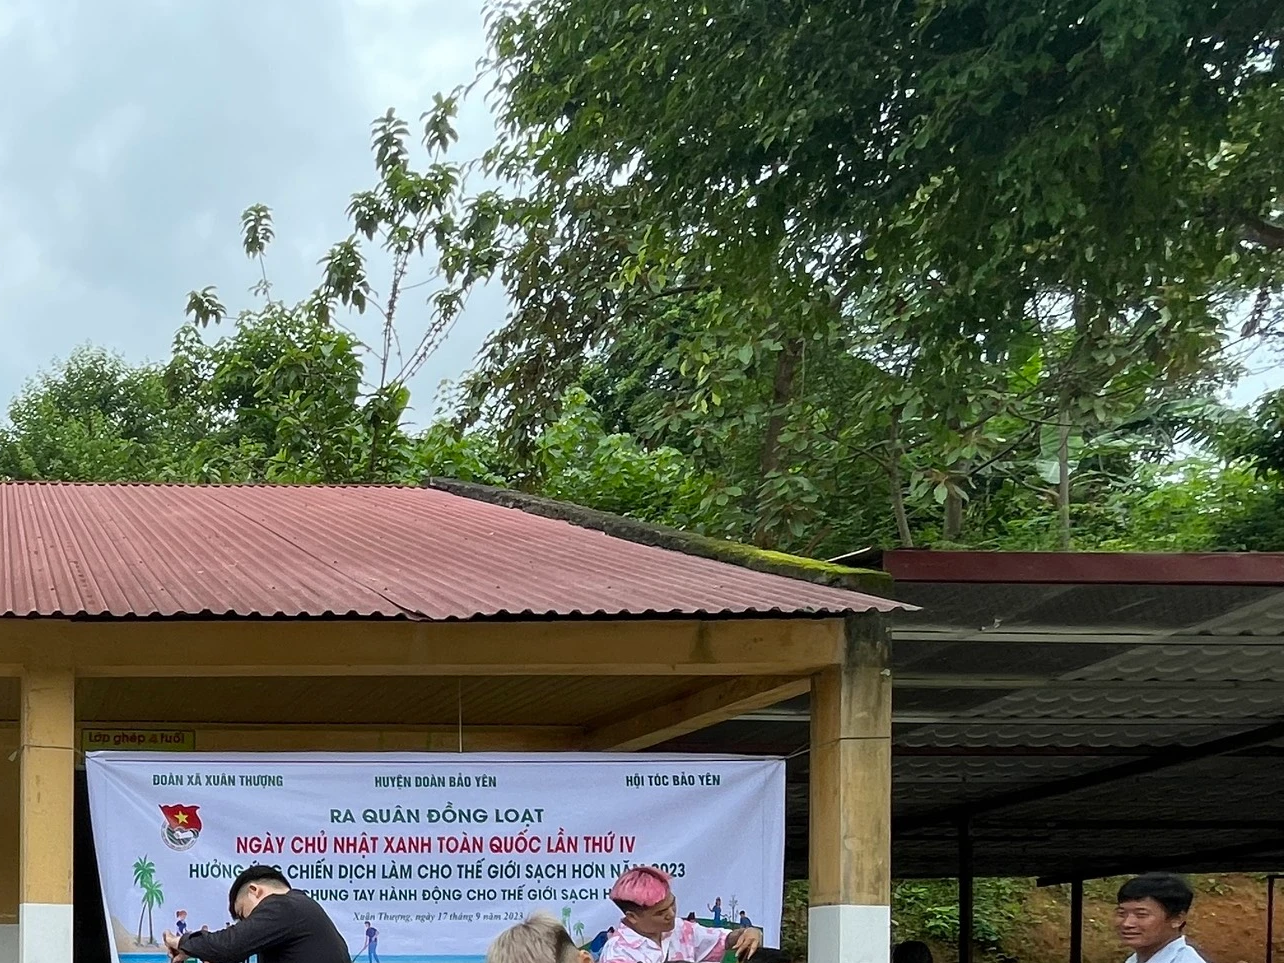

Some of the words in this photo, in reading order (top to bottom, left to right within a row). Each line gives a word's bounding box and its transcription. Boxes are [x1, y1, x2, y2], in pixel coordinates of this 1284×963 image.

[152, 772, 184, 786] ĐOÀN
[187, 772, 202, 787] XÃ
[205, 772, 236, 787] XUÂN
[239, 774, 283, 789] THƯỢNG
[375, 774, 411, 790] HUYỆN
[415, 773, 446, 788] ĐOÀN
[449, 772, 471, 788] BẢO
[475, 773, 497, 788] YÊN
[626, 773, 645, 789] HỘI
[648, 773, 669, 787] TÓC
[672, 771, 695, 786] BẢO
[698, 772, 721, 786] YÊN
[330, 808, 356, 823] RA
[362, 805, 420, 823] QUÂN
[426, 801, 488, 823] ĐỒNG
[495, 808, 544, 827] LOẠT
[236, 831, 285, 855] NGÀY
[290, 829, 328, 854] CHỦ
[333, 832, 378, 859] NHẬT
[383, 836, 432, 853] XANH
[437, 831, 483, 853] TOÀN
[488, 828, 541, 853] QUỐC
[547, 827, 578, 853] LẦN
[583, 831, 616, 853] THỨ
[620, 836, 636, 853] IV
[189, 859, 244, 879] HƯỞNG
[287, 858, 333, 879] CHIẾN
[338, 864, 376, 884] DỊCH
[381, 860, 413, 879] LÀM
[418, 864, 452, 879] CHO
[457, 858, 485, 879] THẾ
[487, 860, 521, 879] GIỚI
[525, 864, 567, 883] SẠCH
[571, 862, 605, 879] HƠN
[354, 889, 376, 901] TAY
[379, 886, 417, 901] HÀNH
[422, 886, 462, 904] ĐỘNG
[467, 889, 497, 901] CHO
[501, 884, 526, 901] THẾ
[528, 885, 557, 901] GIỚI
[561, 888, 598, 904] SẠCH
[353, 912, 376, 921] Xuân
[415, 913, 436, 922] ngày
[438, 912, 449, 921] 17
[449, 912, 474, 922] tháng
[475, 912, 481, 921] 9
[483, 913, 502, 921] năm
[503, 912, 524, 921] 2023
